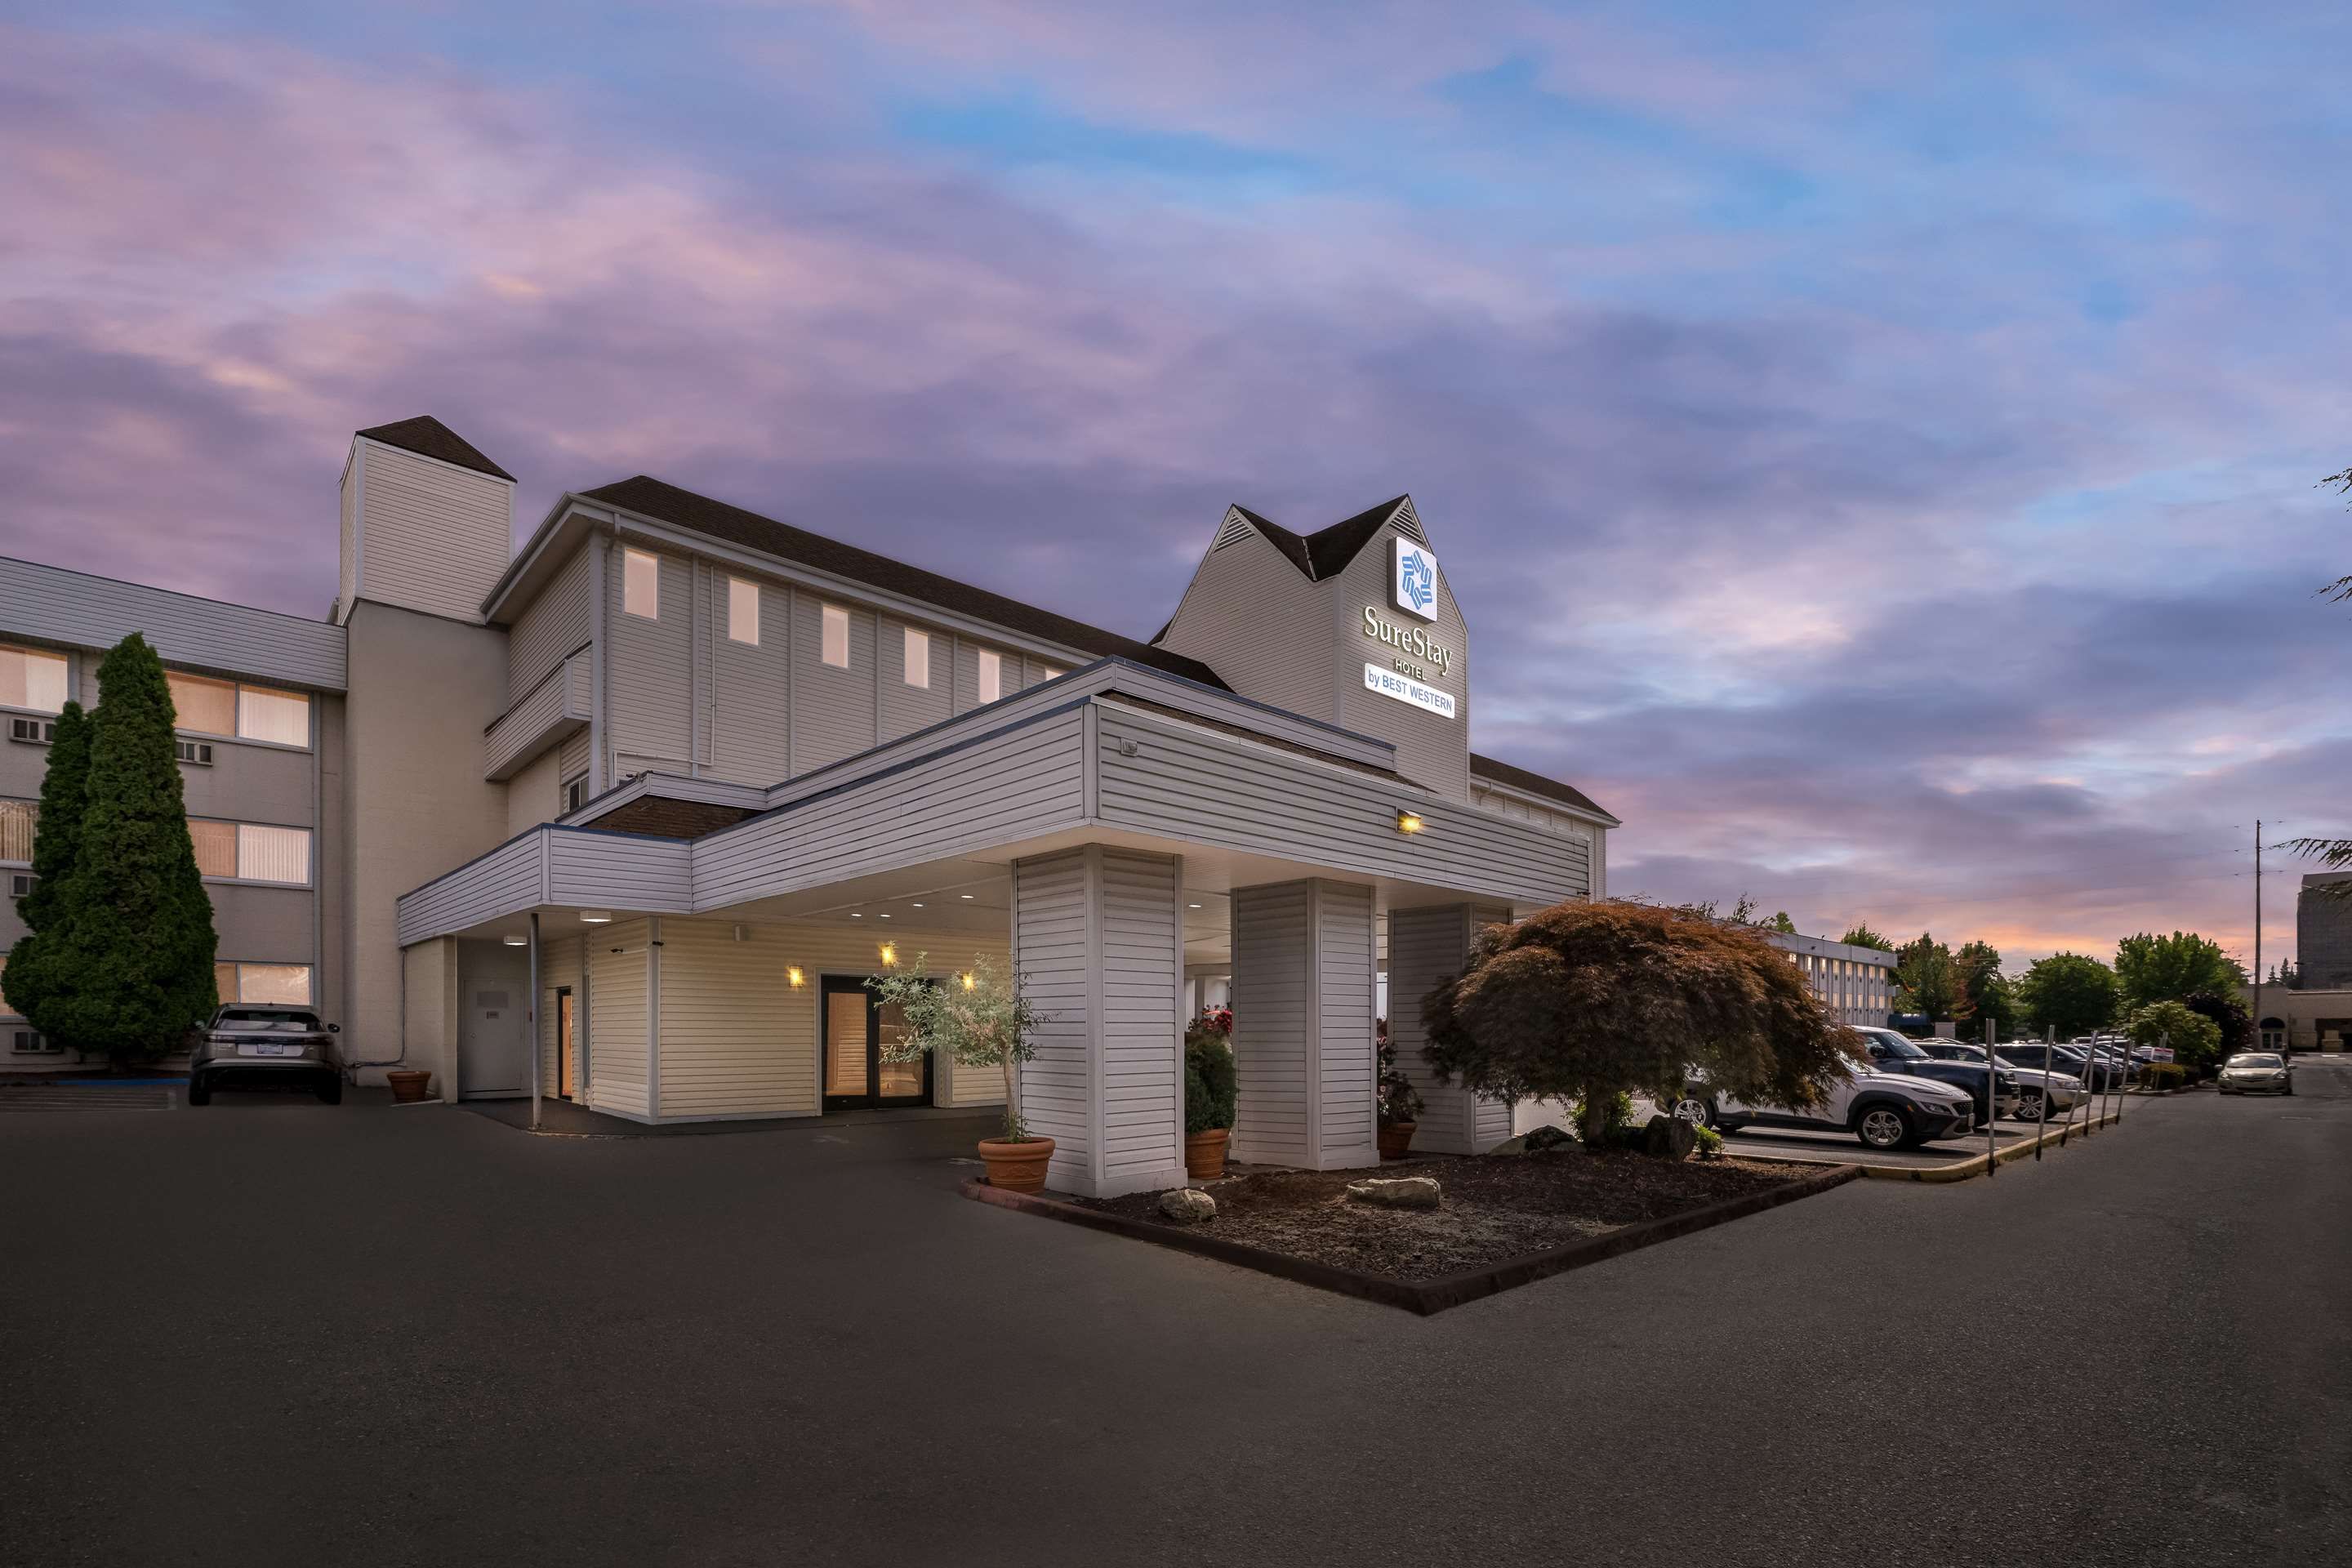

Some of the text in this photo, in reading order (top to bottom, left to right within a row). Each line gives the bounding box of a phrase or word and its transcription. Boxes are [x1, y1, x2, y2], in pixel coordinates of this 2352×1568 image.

[1364, 606, 1452, 676] SureStay
[1368, 669, 1452, 712] by BEST WESTERN
[1395, 658, 1427, 681] HOTEL
